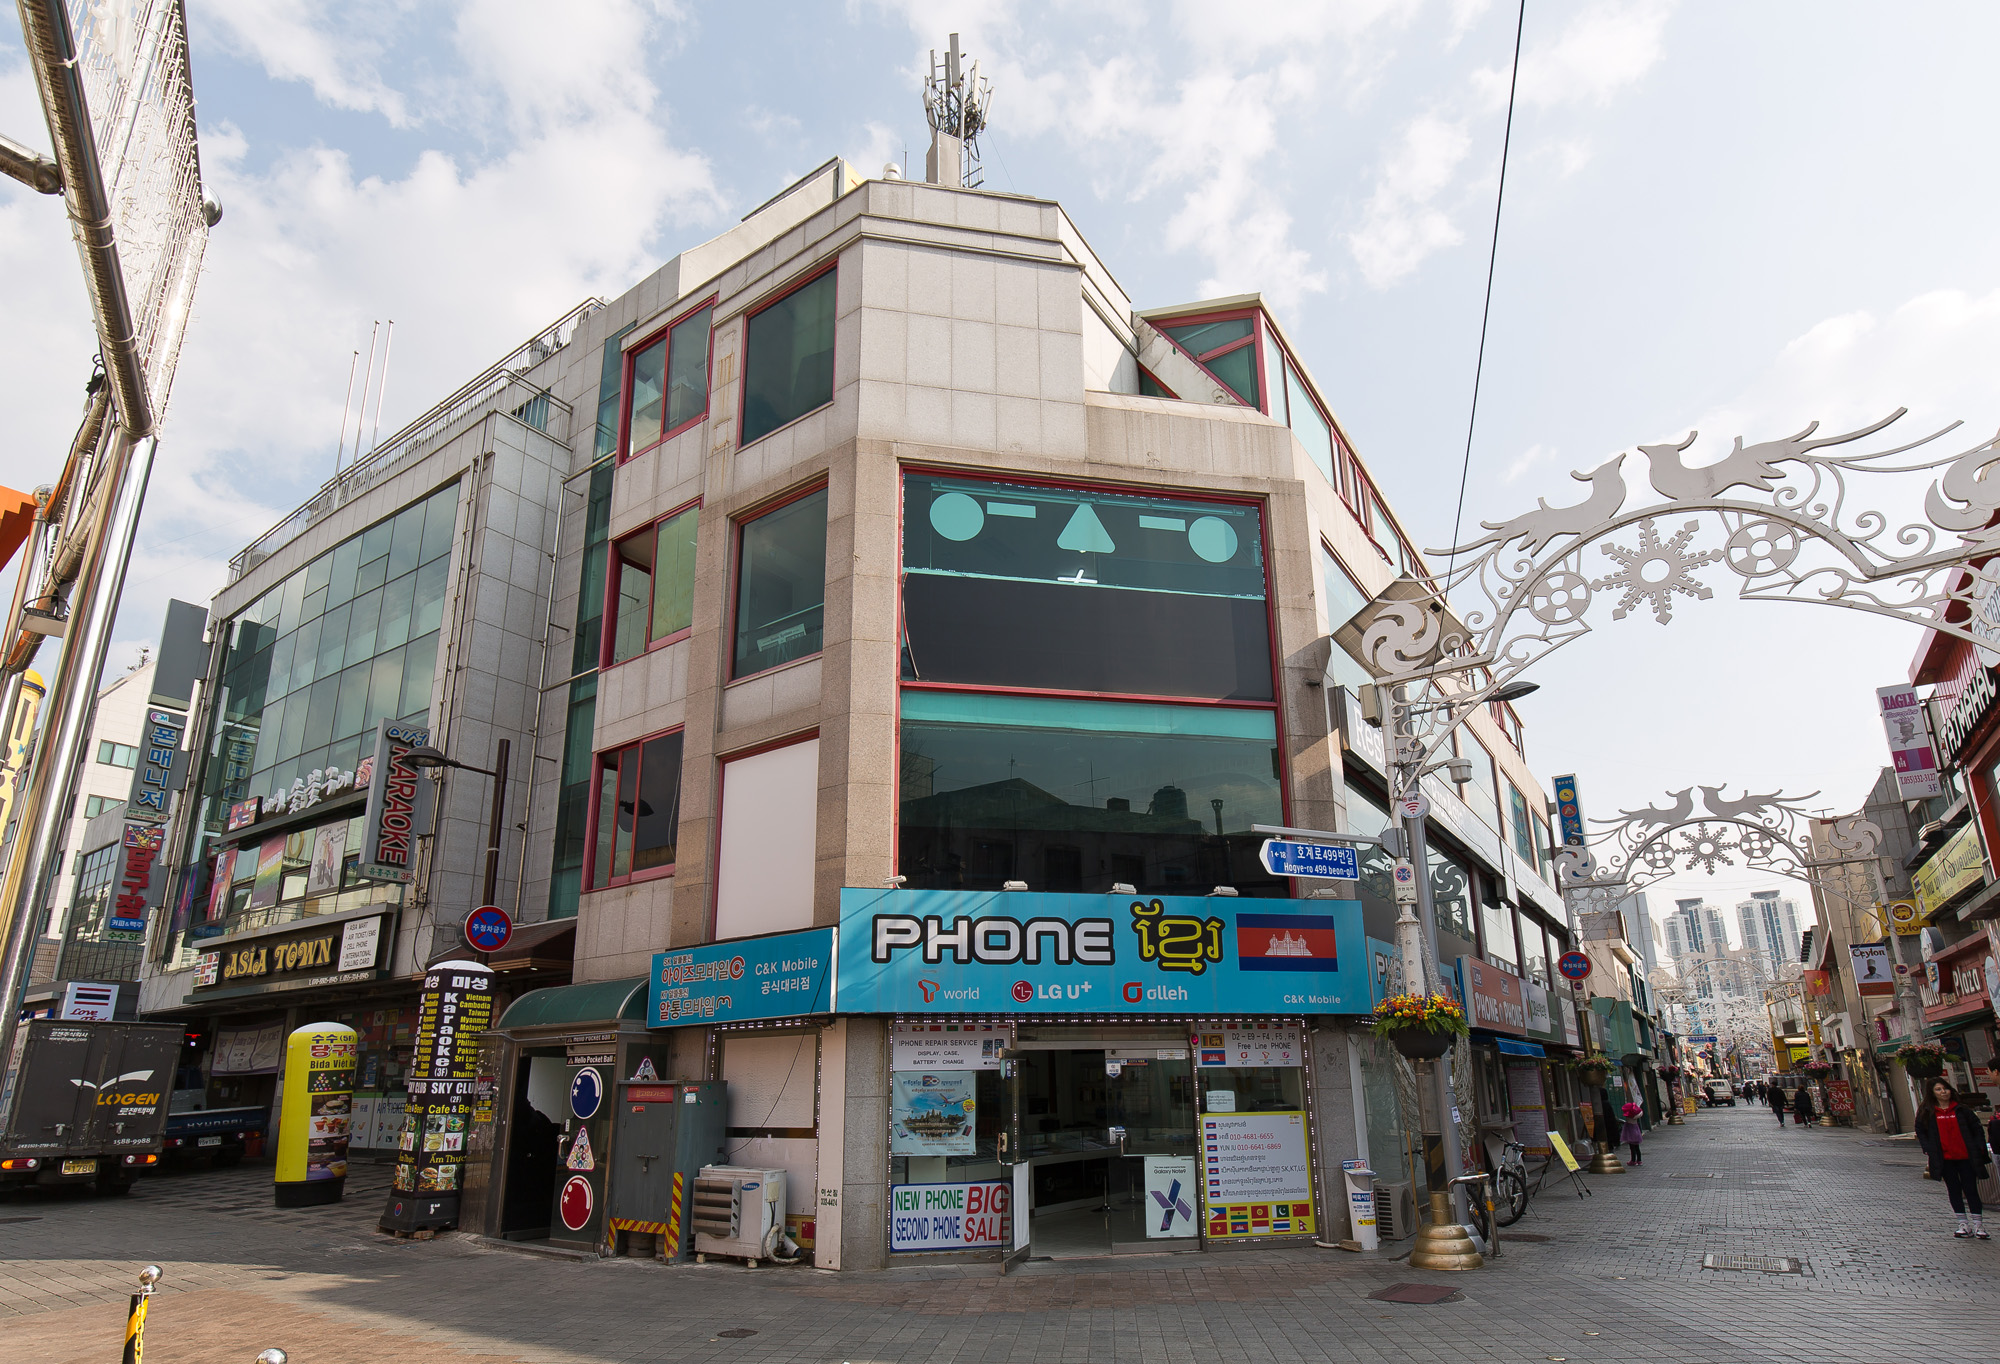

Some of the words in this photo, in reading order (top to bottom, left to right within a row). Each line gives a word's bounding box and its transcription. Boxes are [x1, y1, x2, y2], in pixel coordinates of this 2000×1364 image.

[1881, 692, 1917, 710] EAGLE
[388, 727, 428, 746] 미성
[1353, 705, 1384, 765] Res
[136, 725, 178, 811] 폰매니저
[1928, 784, 1938, 793] 3F
[377, 745, 419, 865] KARAOKE
[1297, 845, 1353, 865] 호계로499번길
[368, 866, 399, 880] 유흥주점
[401, 872, 412, 881] 3F
[1314, 865, 1327, 874] 499
[115, 848, 154, 919] 당구장
[472, 923, 507, 935] 주정차금지
[108, 931, 127, 941] 수수
[128, 932, 141, 942] 5F
[871, 913, 1116, 966] PHONE
[356, 940, 369, 949] PHONE
[273, 935, 334, 972] TOWN
[1852, 948, 1886, 960] Ceylon
[359, 957, 370, 966] CARD
[755, 961, 778, 976] C&K
[781, 957, 818, 973] Mobile
[661, 959, 730, 986] 아이즈모바일
[451, 976, 489, 990] 미성
[761, 976, 810, 995] 공식대리점
[1952, 965, 1981, 998] Plaza
[466, 993, 492, 1002] Vietnam
[943, 986, 980, 1000] world
[1038, 984, 1063, 999] LG
[1146, 985, 1188, 1001] olleh
[459, 1001, 491, 1009] Cambodia
[1283, 994, 1306, 1004] C&K
[1308, 995, 1341, 1004] Mobile
[70, 1008, 99, 1016] Love
[468, 1009, 490, 1017] Taiwan
[1474, 991, 1499, 1023] PHONE
[1503, 1000, 1524, 1028] PHONE
[460, 1016, 489, 1025] Myanmar
[435, 992, 459, 1067] Karaoke
[311, 1034, 338, 1044] 수수
[925, 1039, 948, 1047] REPAIR
[457, 1047, 477, 1055] Pakist
[1237, 1042, 1251, 1050] Free
[1254, 1042, 1267, 1050] Line
[1271, 1042, 1291, 1050] PHONE
[310, 1060, 330, 1069] Bida
[454, 1055, 464, 1063] Sri
[466, 1055, 477, 1063] Lan
[574, 1056, 586, 1064] Hello
[587, 1055, 603, 1063] Pocket
[465, 1062, 477, 1070] Spa
[434, 1068, 448, 1077] (3F)
[431, 1082, 453, 1094] SKY
[456, 1082, 475, 1094] CLU
[97, 1093, 160, 1106] LOGEN
[450, 1095, 462, 1103] (2F)
[117, 1107, 157, 1116] 로젠택배
[387, 1102, 405, 1114] TICKE
[428, 1104, 450, 1114] Cafe
[451, 1105, 457, 1113] &
[187, 1118, 243, 1129] HYUNDAI
[113, 1137, 151, 1146] 1588-9988
[1237, 1143, 1282, 1151] 010-6641-6869
[895, 1191, 920, 1211] NEW
[925, 1189, 964, 1210] PHONE
[966, 1185, 1010, 1215] BIG
[895, 1217, 930, 1242] SECOND
[933, 1216, 960, 1240] PHONE
[964, 1216, 1011, 1243] SALE
